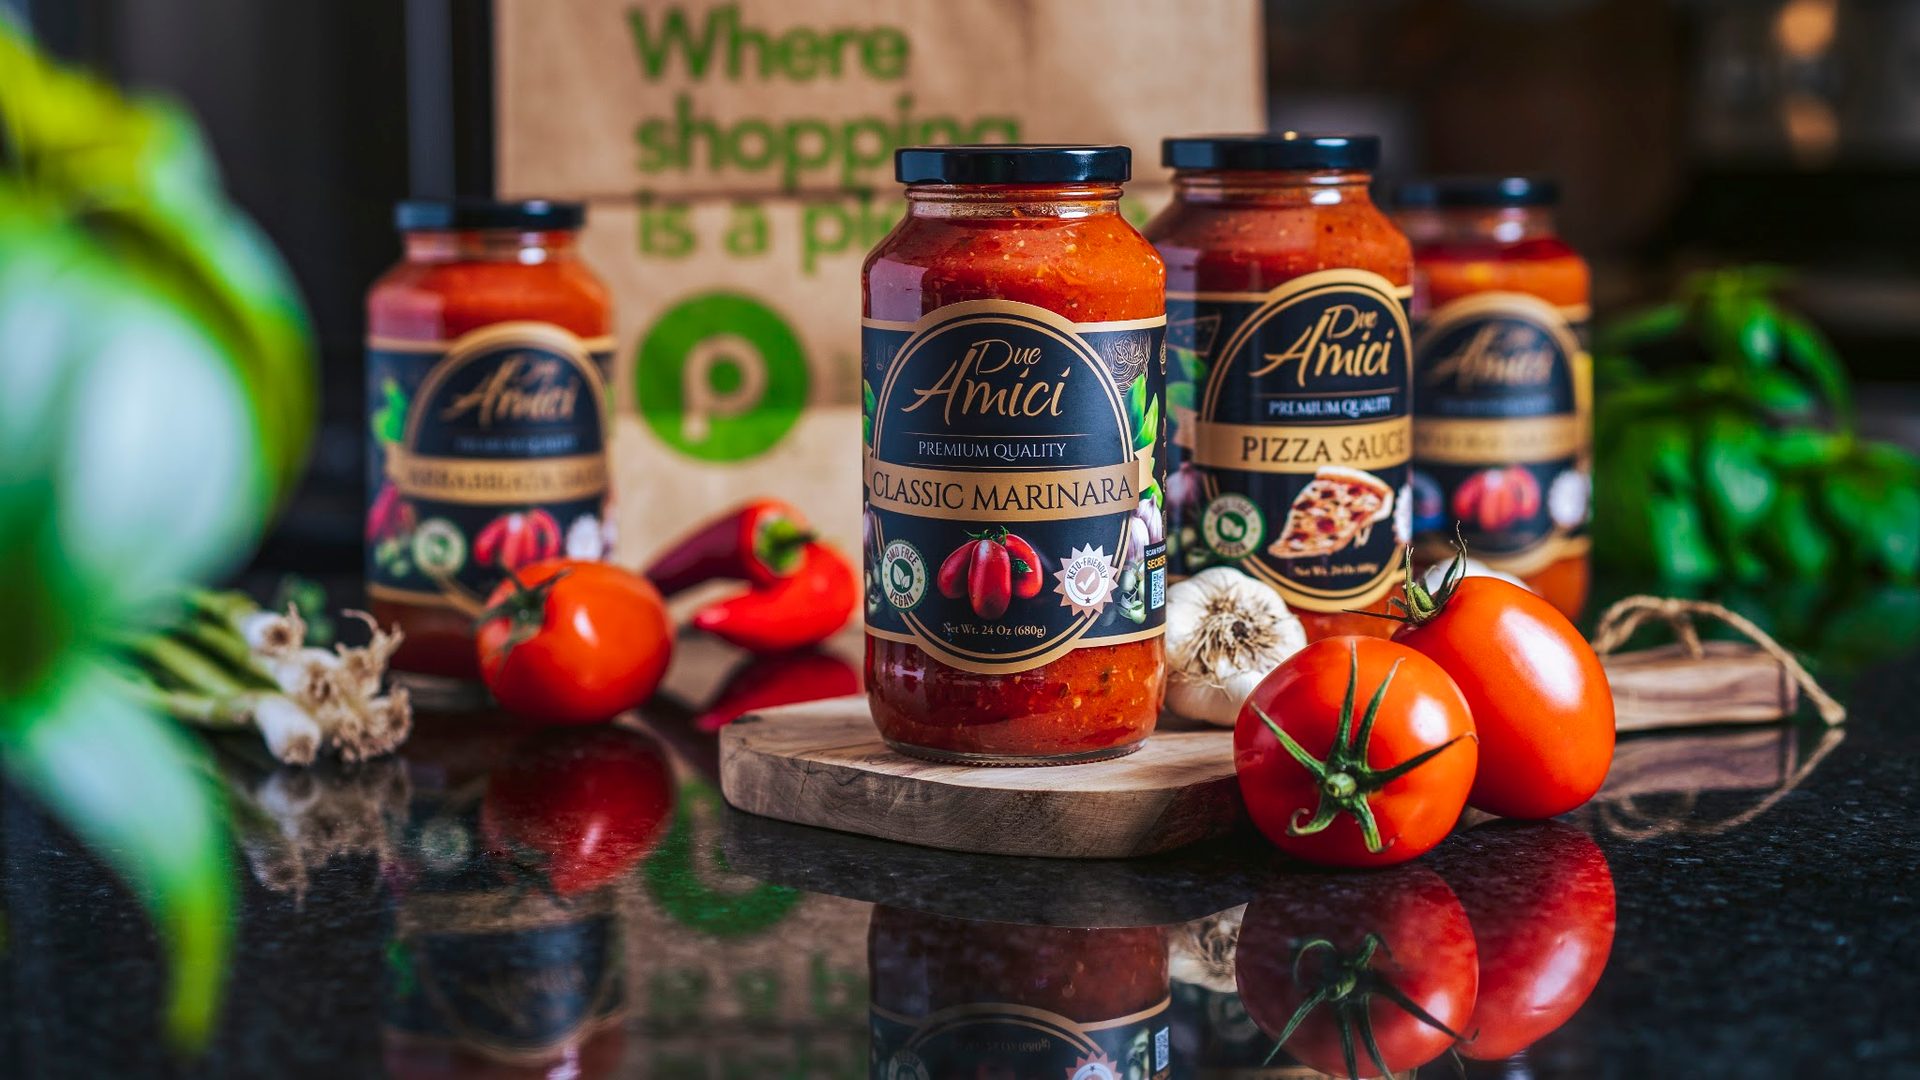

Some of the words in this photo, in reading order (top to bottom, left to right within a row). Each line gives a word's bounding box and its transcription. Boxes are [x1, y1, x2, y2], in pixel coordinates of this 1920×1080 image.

[629, 6, 910, 81] Where
[639, 187, 696, 257] is
[724, 202, 769, 257] a
[971, 339, 1042, 375] Due
[1250, 312, 1394, 387] Amici
[901, 347, 1071, 425] Amici
[1268, 399, 1339, 416] PREMIUM
[1341, 396, 1393, 418] QUALITY
[919, 441, 990, 458] PREMIUM
[993, 442, 1067, 462] QUALITY
[1241, 436, 1332, 463] PIZZA
[873, 471, 964, 510] CLASSIC
[971, 475, 1134, 511] MARINARA
[886, 546, 900, 564] GMO
[901, 546, 920, 567] FREE
[1066, 557, 1108, 580] KETO-FRIENDLY
[889, 588, 915, 608] VEGAN
[943, 622, 959, 633] Net
[961, 623, 979, 635] Wt.
[981, 625, 994, 635] 24
[996, 624, 1013, 636] Oz
[1014, 624, 1047, 639] (680g)
